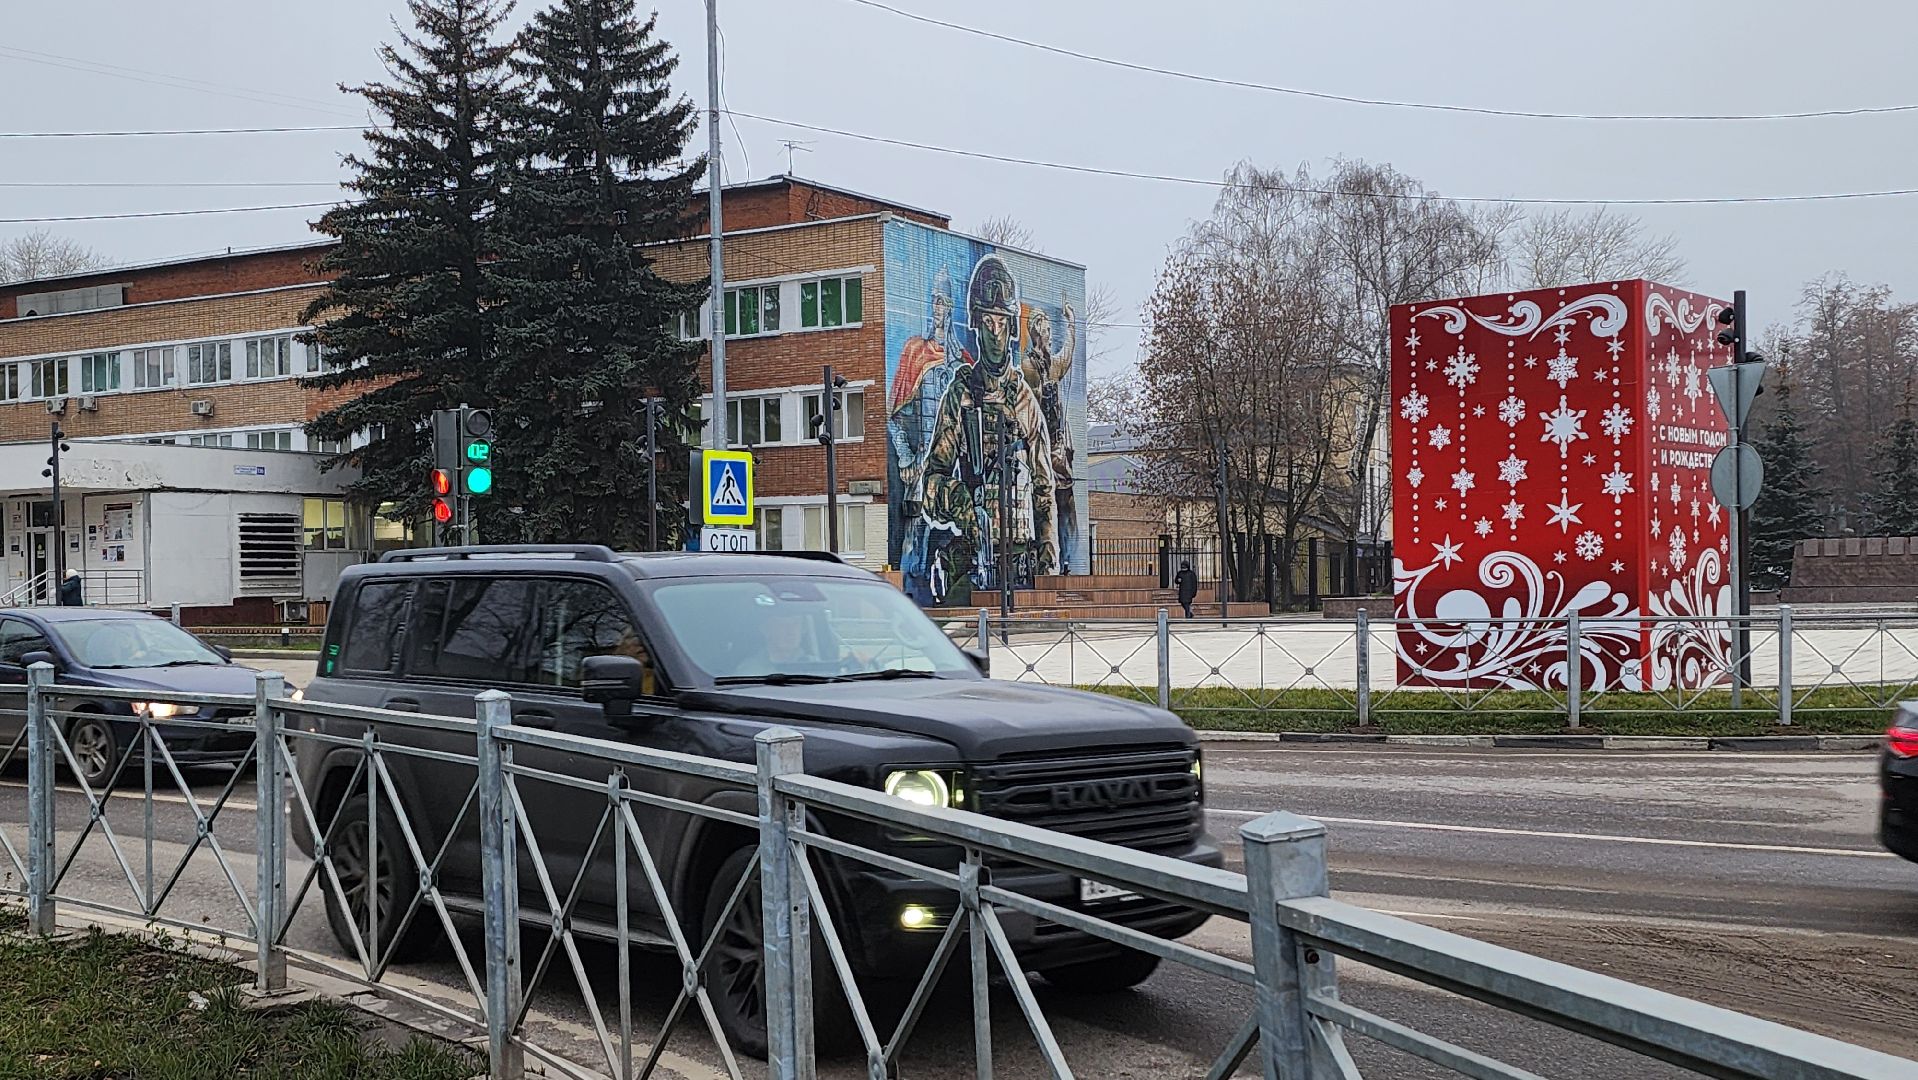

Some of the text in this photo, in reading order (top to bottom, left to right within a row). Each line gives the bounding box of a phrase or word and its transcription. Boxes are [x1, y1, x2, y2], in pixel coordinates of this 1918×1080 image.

[1660, 425, 1726, 447] С НОВЫМ ГОДОМ
[1661, 449, 1716, 469] И РОЖДЕСТВ
[710, 534, 748, 551] СТОП
